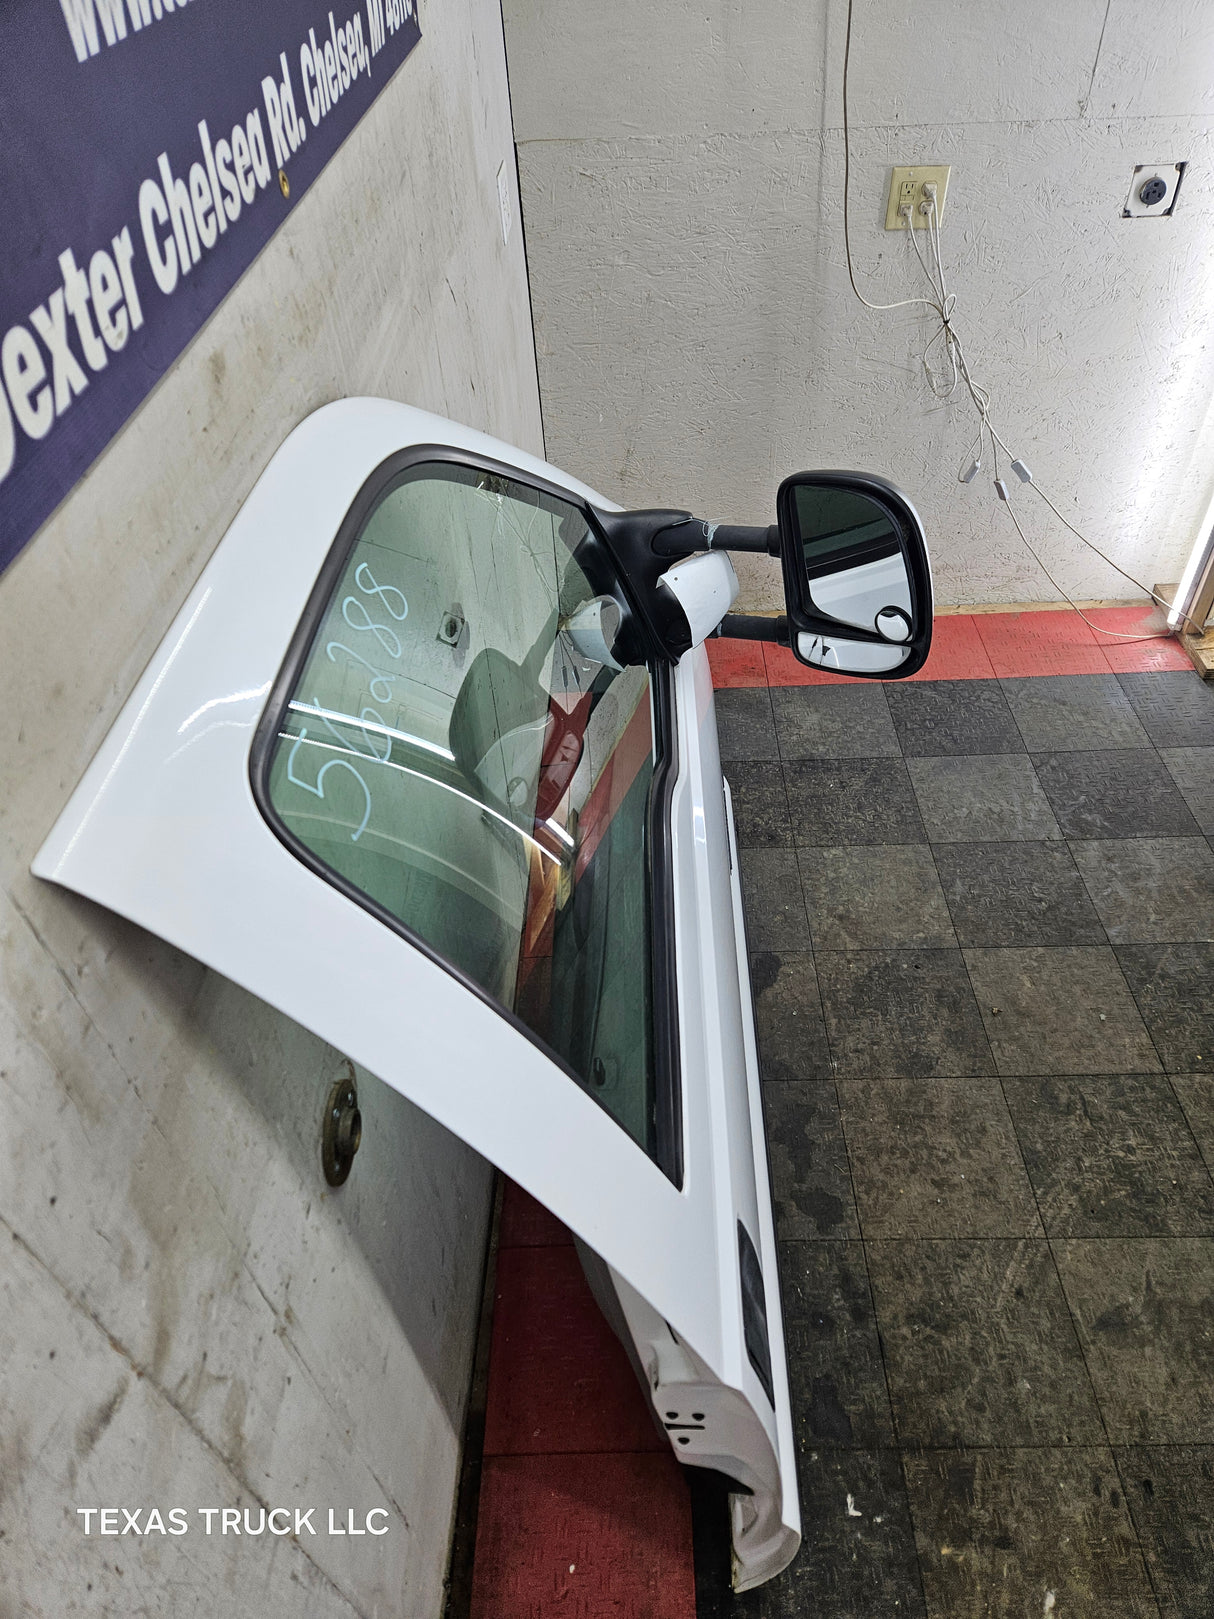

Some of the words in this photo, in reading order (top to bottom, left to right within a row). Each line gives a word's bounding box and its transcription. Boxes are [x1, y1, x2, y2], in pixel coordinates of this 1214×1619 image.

[139, 119, 271, 294] Chelsea
[261, 51, 307, 169] Rd.
[300, 11, 371, 127] Chelsea,
[287, 562, 408, 841] 56288
